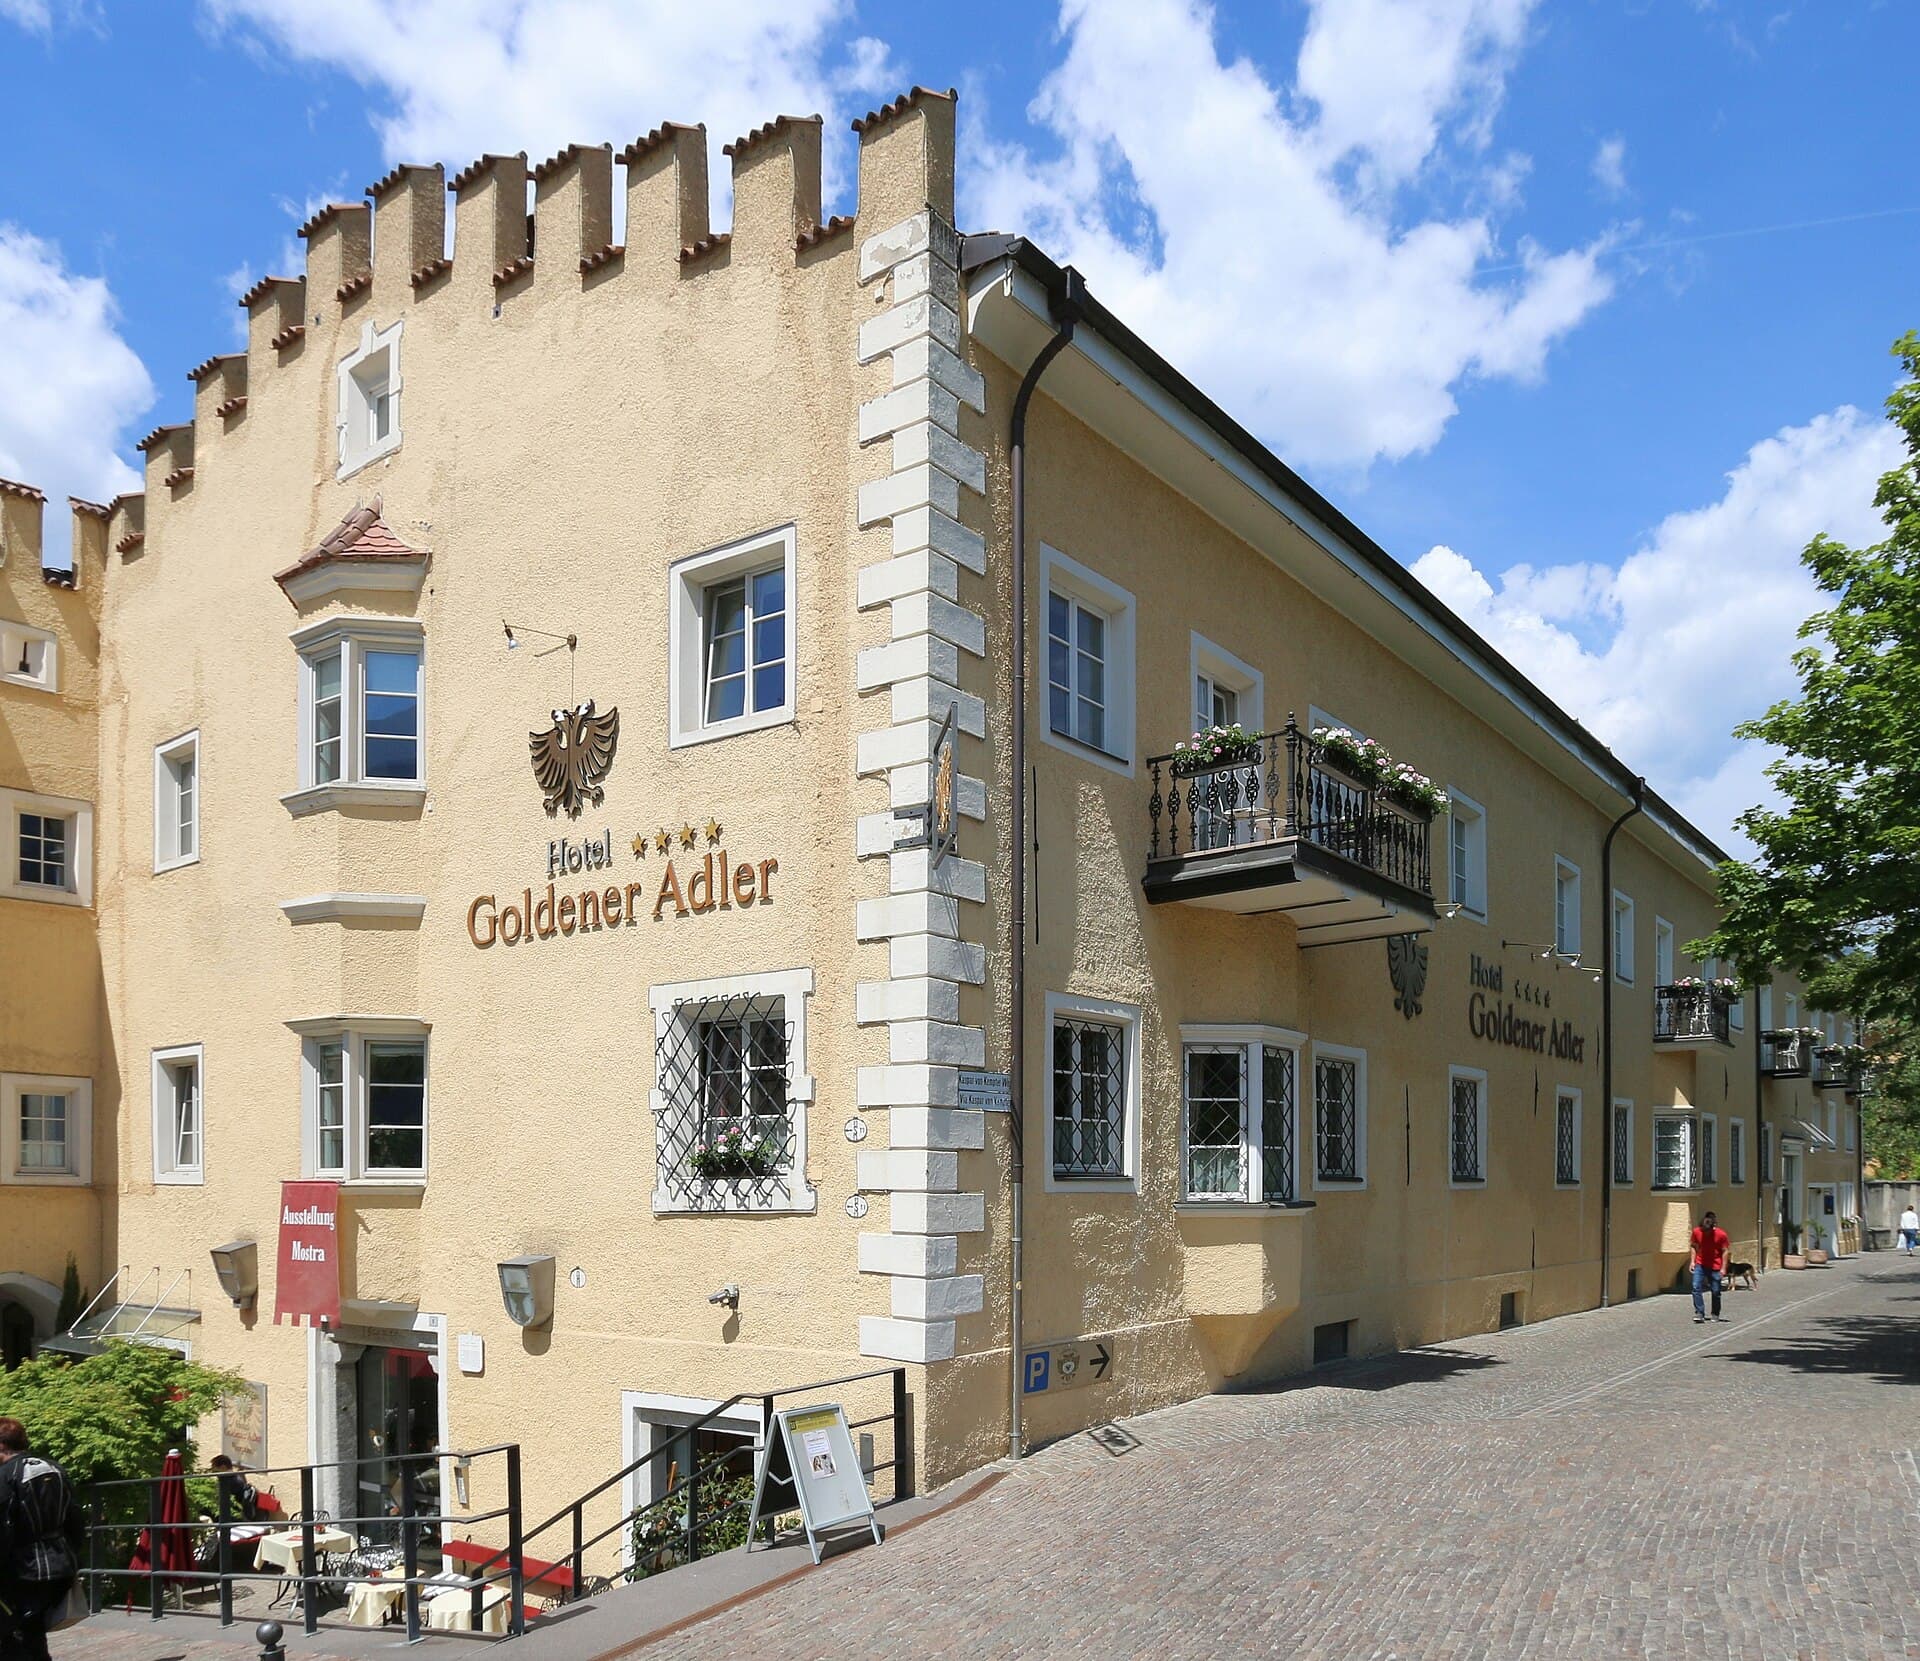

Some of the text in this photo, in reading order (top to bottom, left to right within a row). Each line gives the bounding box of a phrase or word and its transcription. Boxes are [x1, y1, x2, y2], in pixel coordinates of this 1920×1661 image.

[545, 828, 613, 876] Hotel
[467, 849, 779, 949] Goldener Adler
[1470, 953, 1503, 993] Hotel
[1469, 992, 1585, 1064] Goldener Adler
[282, 1205, 335, 1231] Ausstellung
[291, 1241, 325, 1262] Mostra
[1029, 1357, 1046, 1388] P
